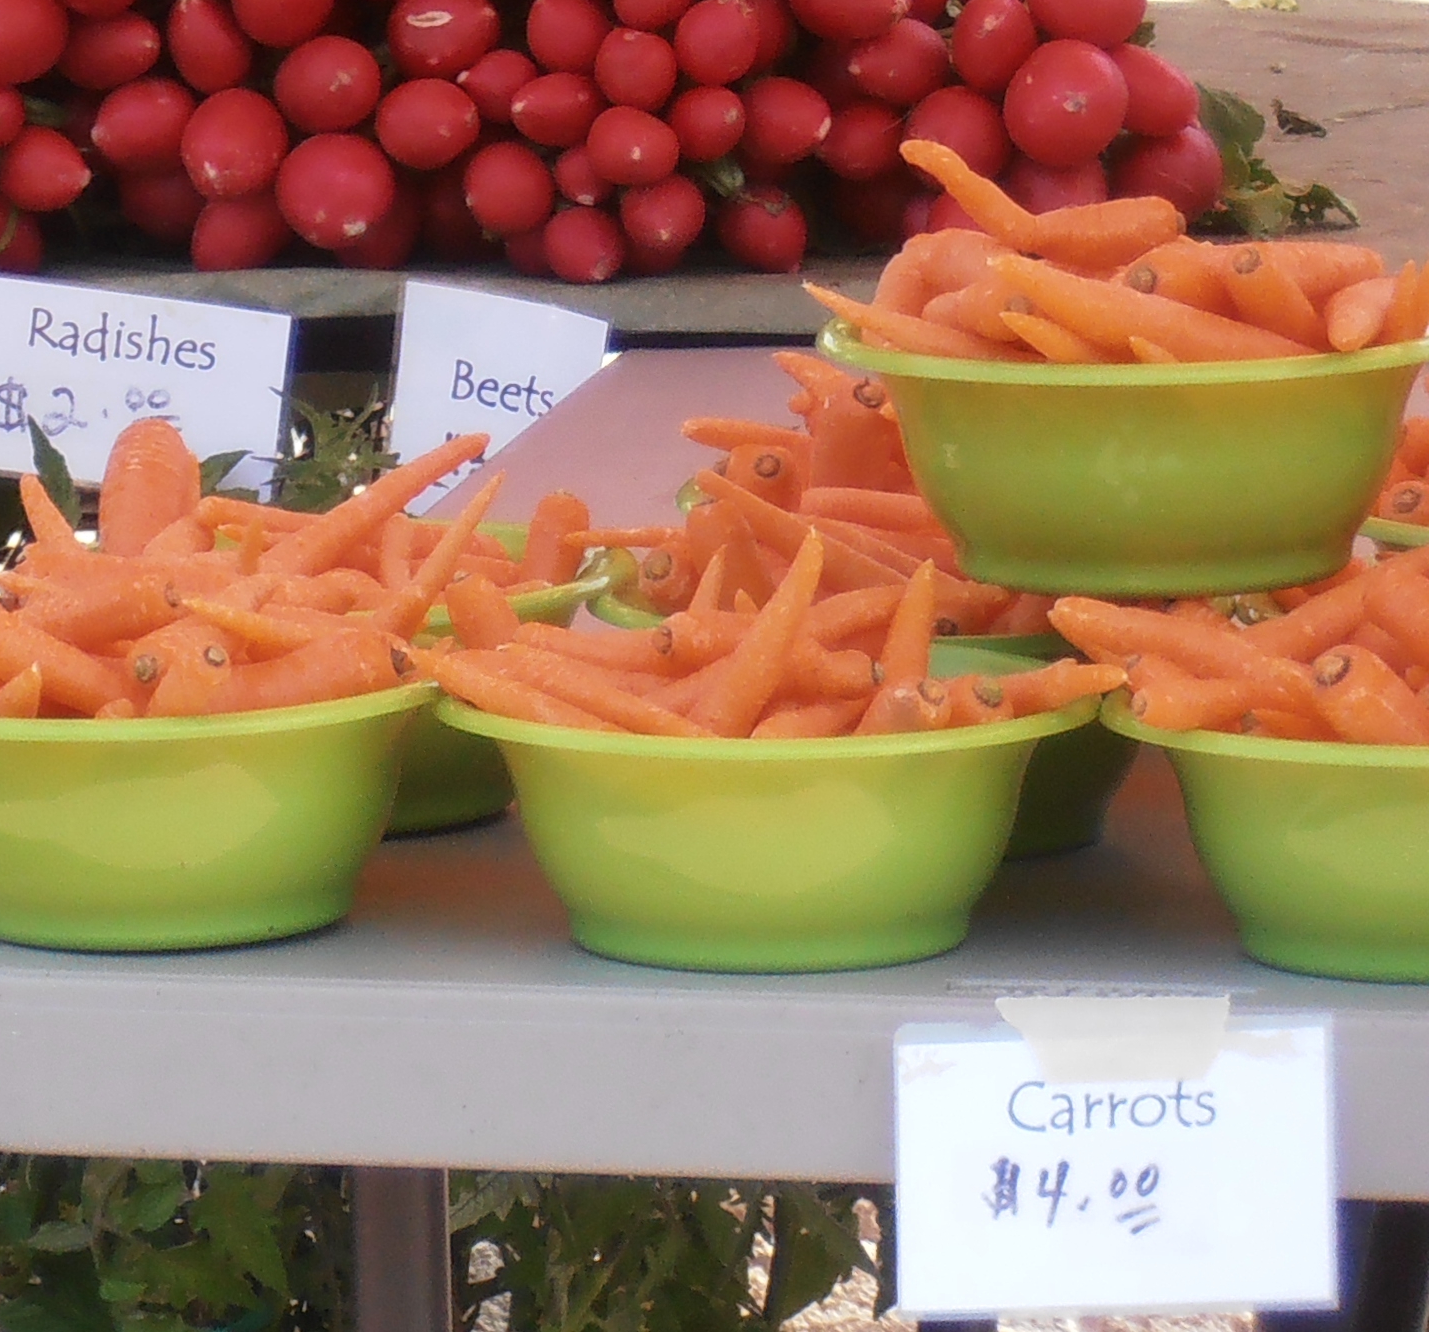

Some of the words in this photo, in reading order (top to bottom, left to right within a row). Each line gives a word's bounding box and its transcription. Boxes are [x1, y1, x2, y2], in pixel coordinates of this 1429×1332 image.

[28, 307, 216, 370] Radishes
[451, 359, 554, 416] Beets
[1008, 1080, 1217, 1135] Carrots
